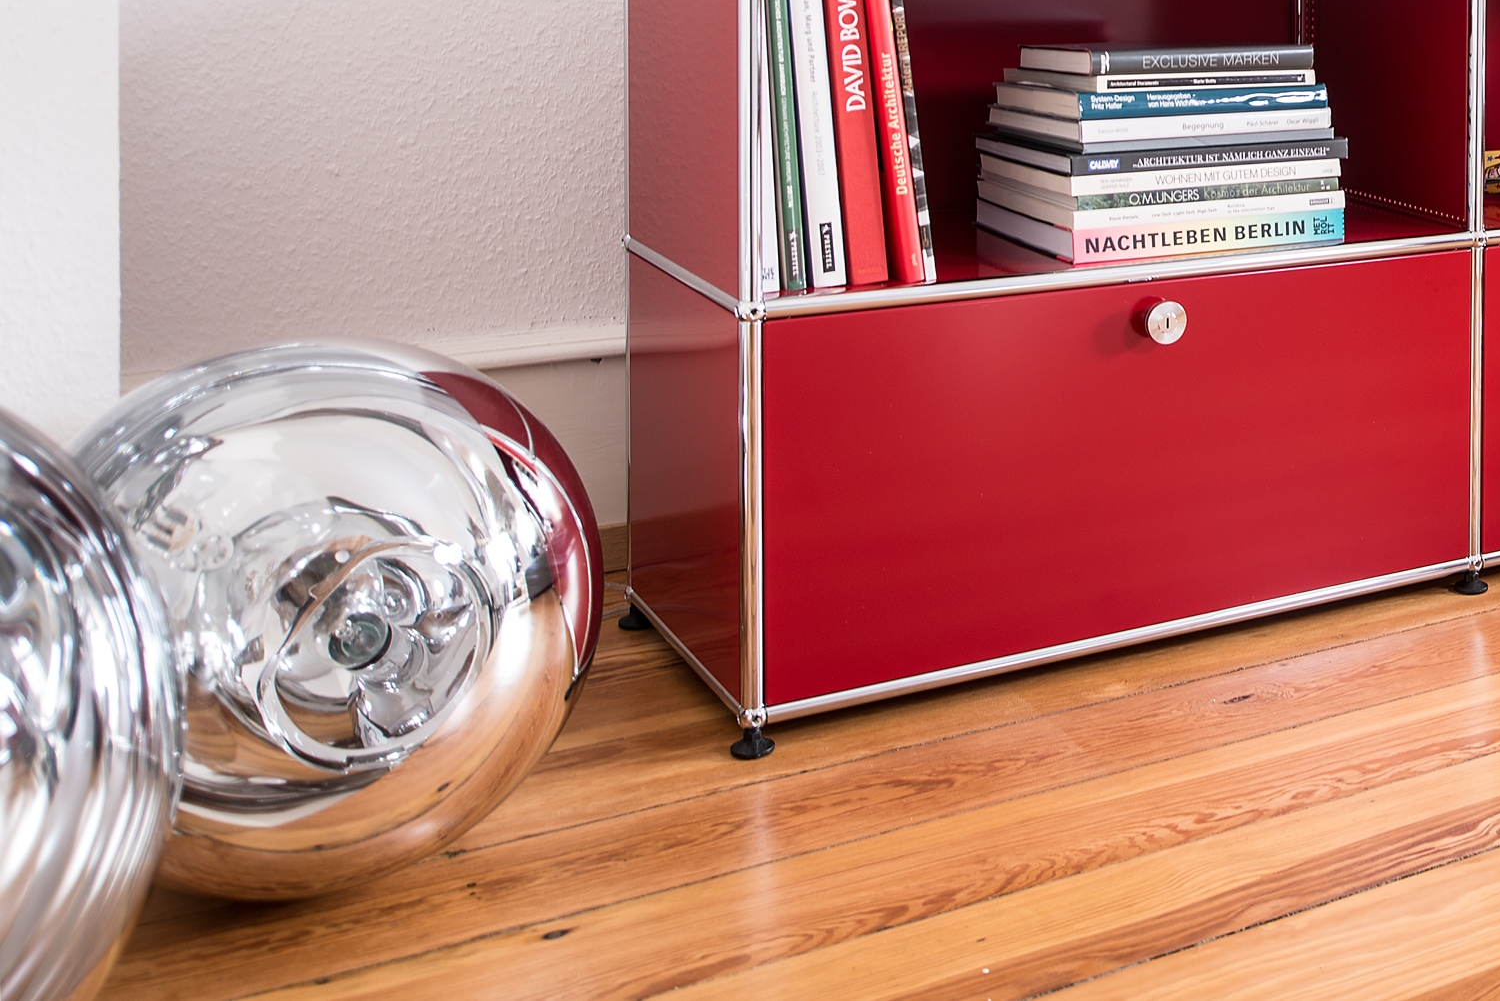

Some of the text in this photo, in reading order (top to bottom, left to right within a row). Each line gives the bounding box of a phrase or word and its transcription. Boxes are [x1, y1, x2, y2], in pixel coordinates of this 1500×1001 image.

[808, 54, 817, 83] Partner
[1142, 52, 1280, 69] EXCLUSIVE MARKEN
[841, 43, 867, 113] DAVID
[1090, 93, 1191, 104] System-Design Herausgegeben
[881, 52, 908, 196] Deutsche Architektur
[1182, 121, 1224, 132] Begegnung
[1205, 152, 1220, 163] IST
[1222, 150, 1263, 161] NÄMLICH
[1264, 149, 1288, 159] GANZ
[1155, 166, 1297, 186] WOHNEN MIT GUTEM DESIGN
[1203, 186, 1241, 199] Kosmos
[1242, 184, 1259, 196] der
[1260, 183, 1311, 196] Architektur
[1085, 219, 1306, 254] NACHTLEBEN BERLIN
[791, 239, 799, 278] PRESTEL
[821, 233, 834, 270] PRESTEL
